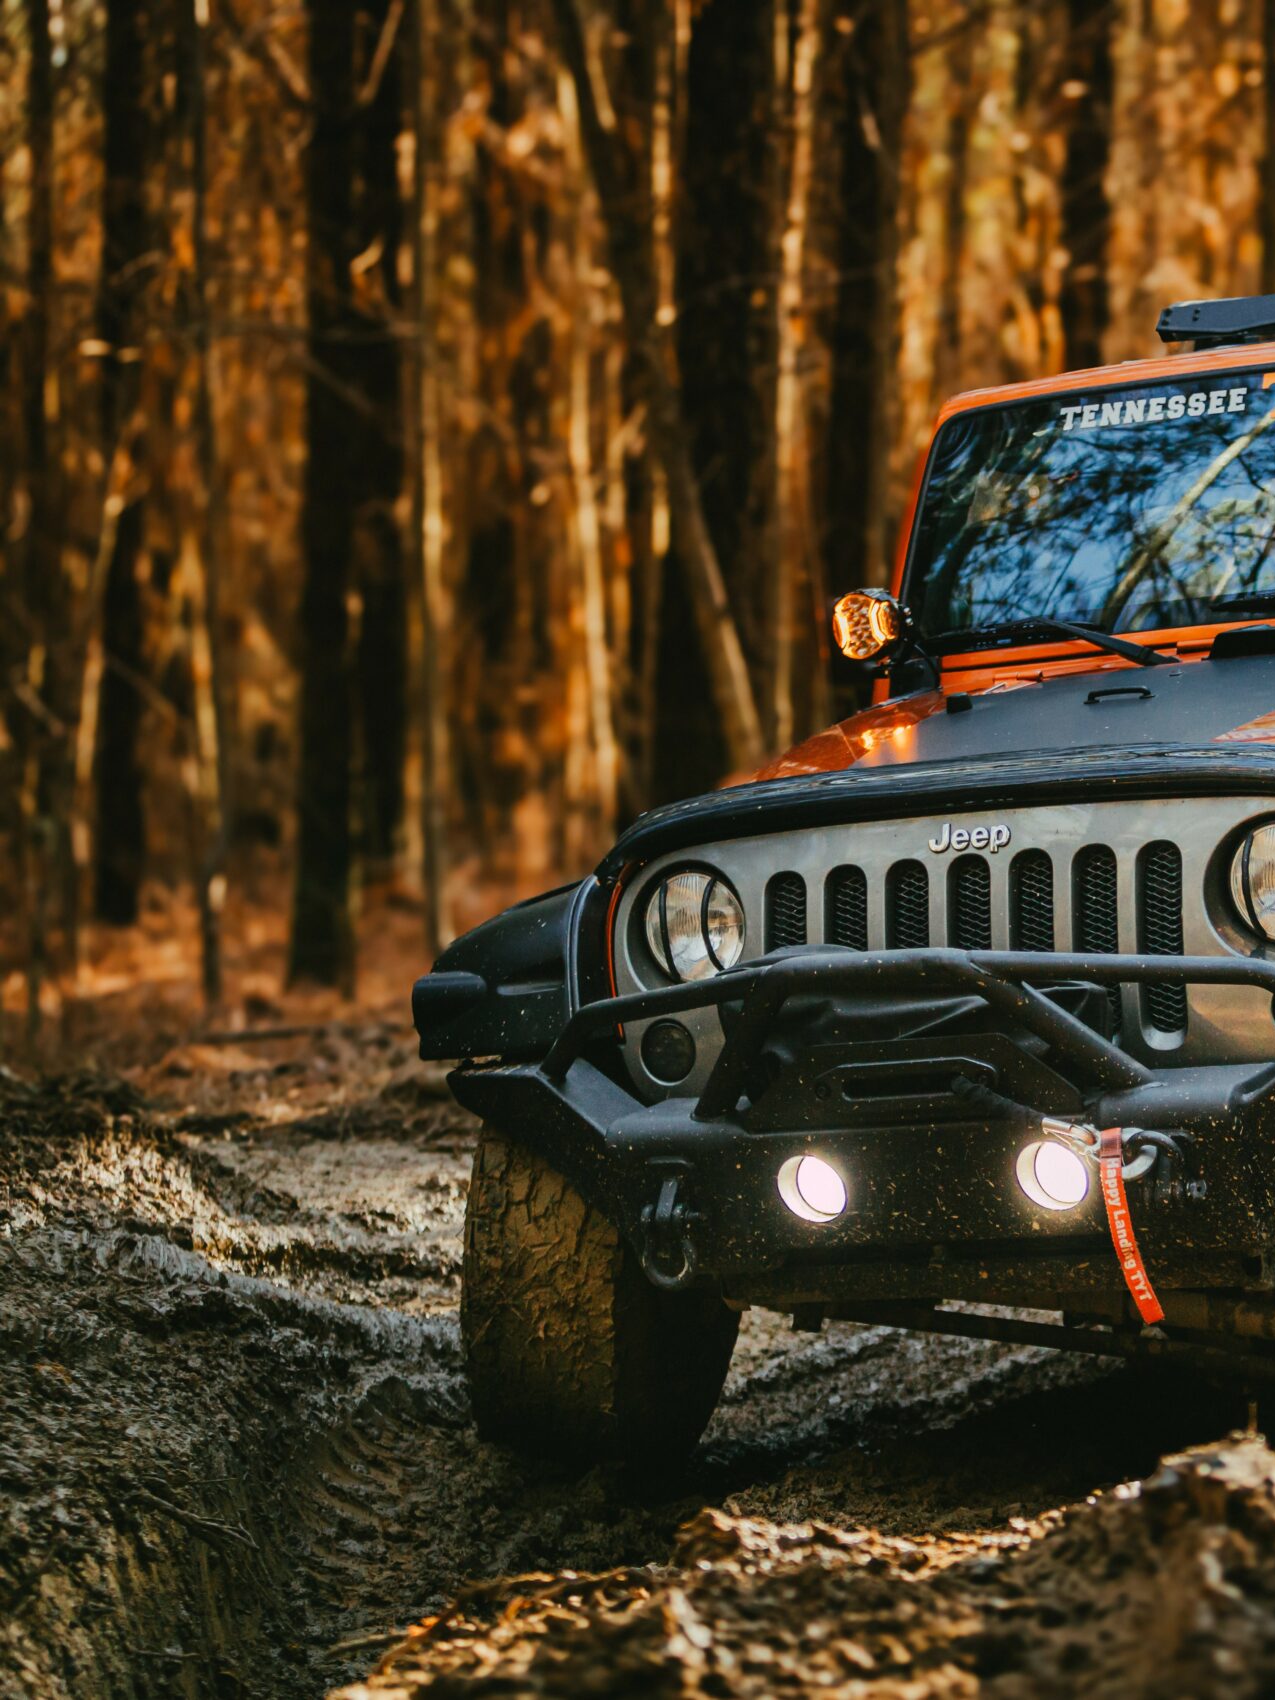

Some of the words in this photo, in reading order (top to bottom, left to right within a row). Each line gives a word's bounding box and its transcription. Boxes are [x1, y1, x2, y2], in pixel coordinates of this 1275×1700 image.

[1060, 387, 1248, 431] TENNESSEE
[928, 823, 1011, 853] Jeep
[1105, 1157, 1122, 1207] Happy
[1113, 1209, 1137, 1270] Landing
[1130, 1270, 1152, 1301] TYT
